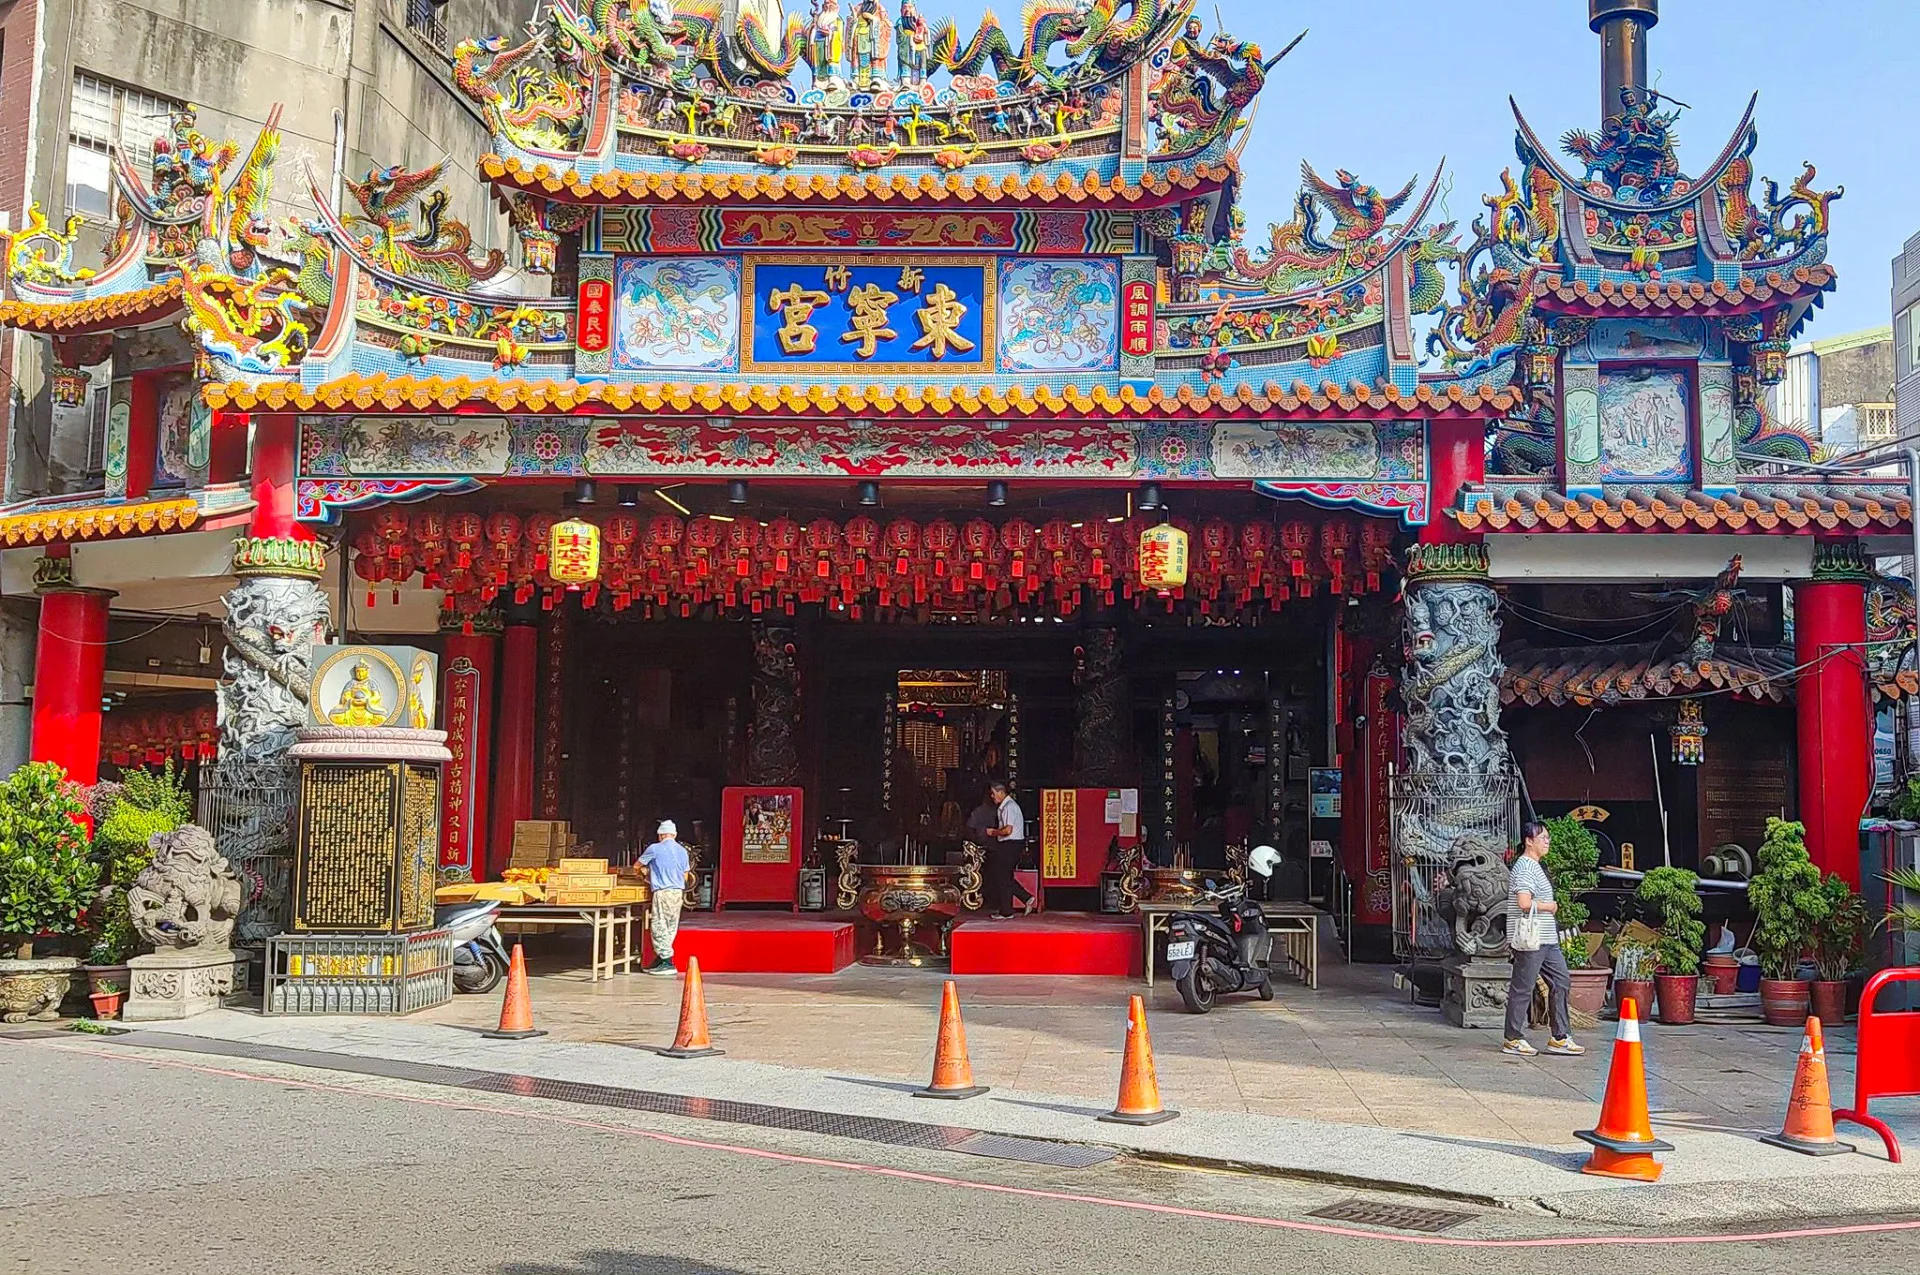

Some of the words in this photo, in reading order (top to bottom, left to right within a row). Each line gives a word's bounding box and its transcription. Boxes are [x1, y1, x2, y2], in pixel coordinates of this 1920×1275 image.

[585, 284, 603, 348] 國泰民安
[1129, 286, 1149, 351] 風調雨順
